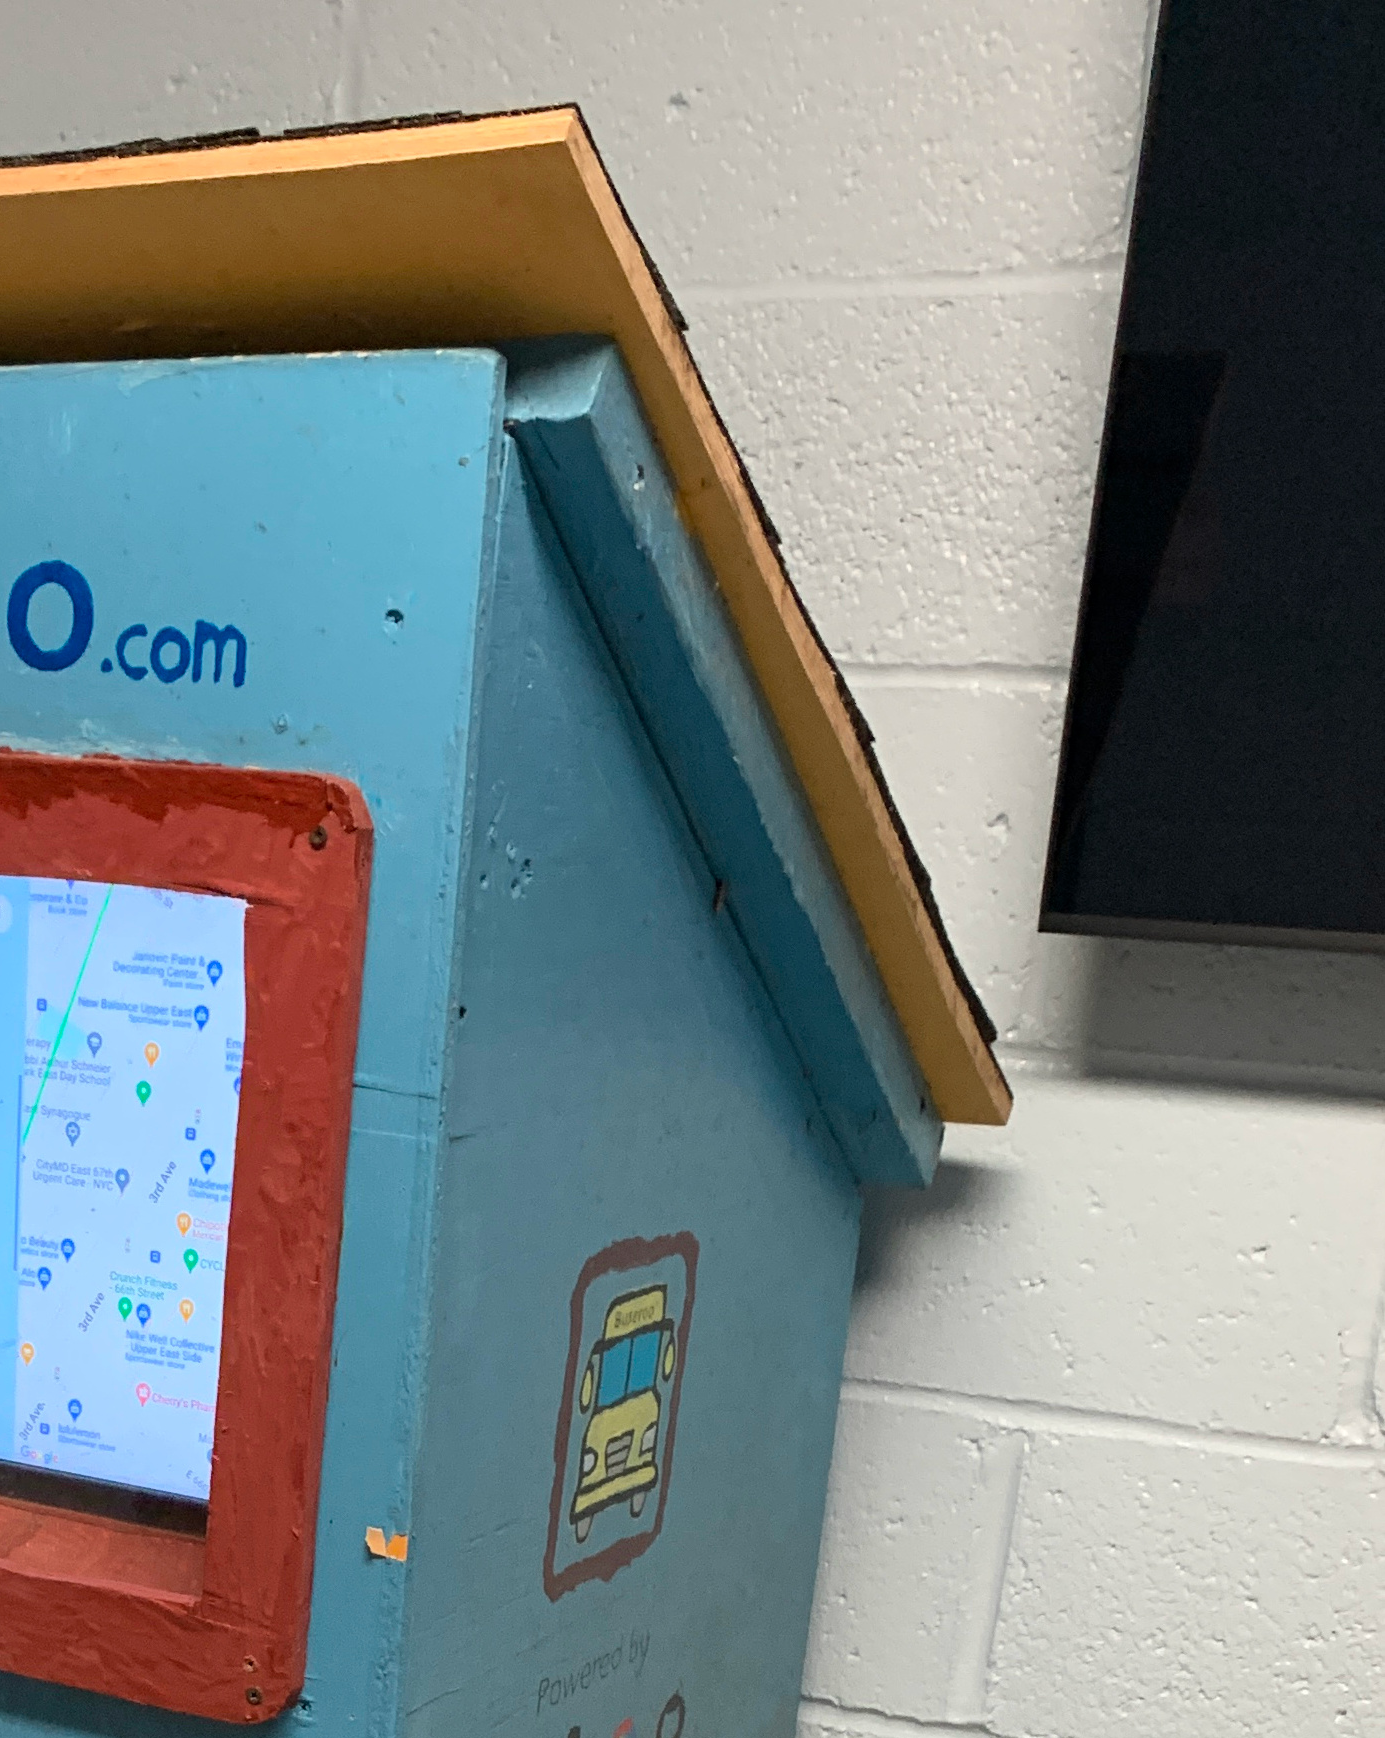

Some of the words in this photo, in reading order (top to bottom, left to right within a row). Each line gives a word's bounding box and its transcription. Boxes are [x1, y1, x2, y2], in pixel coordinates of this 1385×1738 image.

[101, 999, 139, 1013] Balance
[140, 1003, 169, 1018] Upper
[171, 1006, 192, 1019] East
[59, 1070, 77, 1084] Day
[79, 1072, 111, 1087] School
[40, 1104, 91, 1122] Synagogue
[35, 1158, 69, 1173] CityMD
[70, 1164, 91, 1176] East
[33, 1171, 62, 1187] Urgent
[64, 1175, 86, 1188] Care
[93, 1180, 114, 1192] NYC
[148, 1182, 165, 1204] 3rd
[161, 1160, 177, 1182] Ave
[109, 1271, 143, 1286] Crunch
[144, 1276, 178, 1291] Fitness
[137, 1287, 165, 1301] Street
[77, 1311, 94, 1333] 3rd
[89, 1292, 105, 1314] Ave
[614, 1305, 655, 1328] Buseroo
[126, 1329, 146, 1342] Nike
[148, 1332, 168, 1345] Well
[170, 1337, 215, 1353] Collective
[130, 1342, 157, 1358] Upper
[159, 1347, 181, 1360] East
[182, 1350, 202, 1363] Side
[19, 1421, 34, 1441] 3rd
[536, 1633, 624, 1718] Powered
[628, 1628, 651, 1679] by
